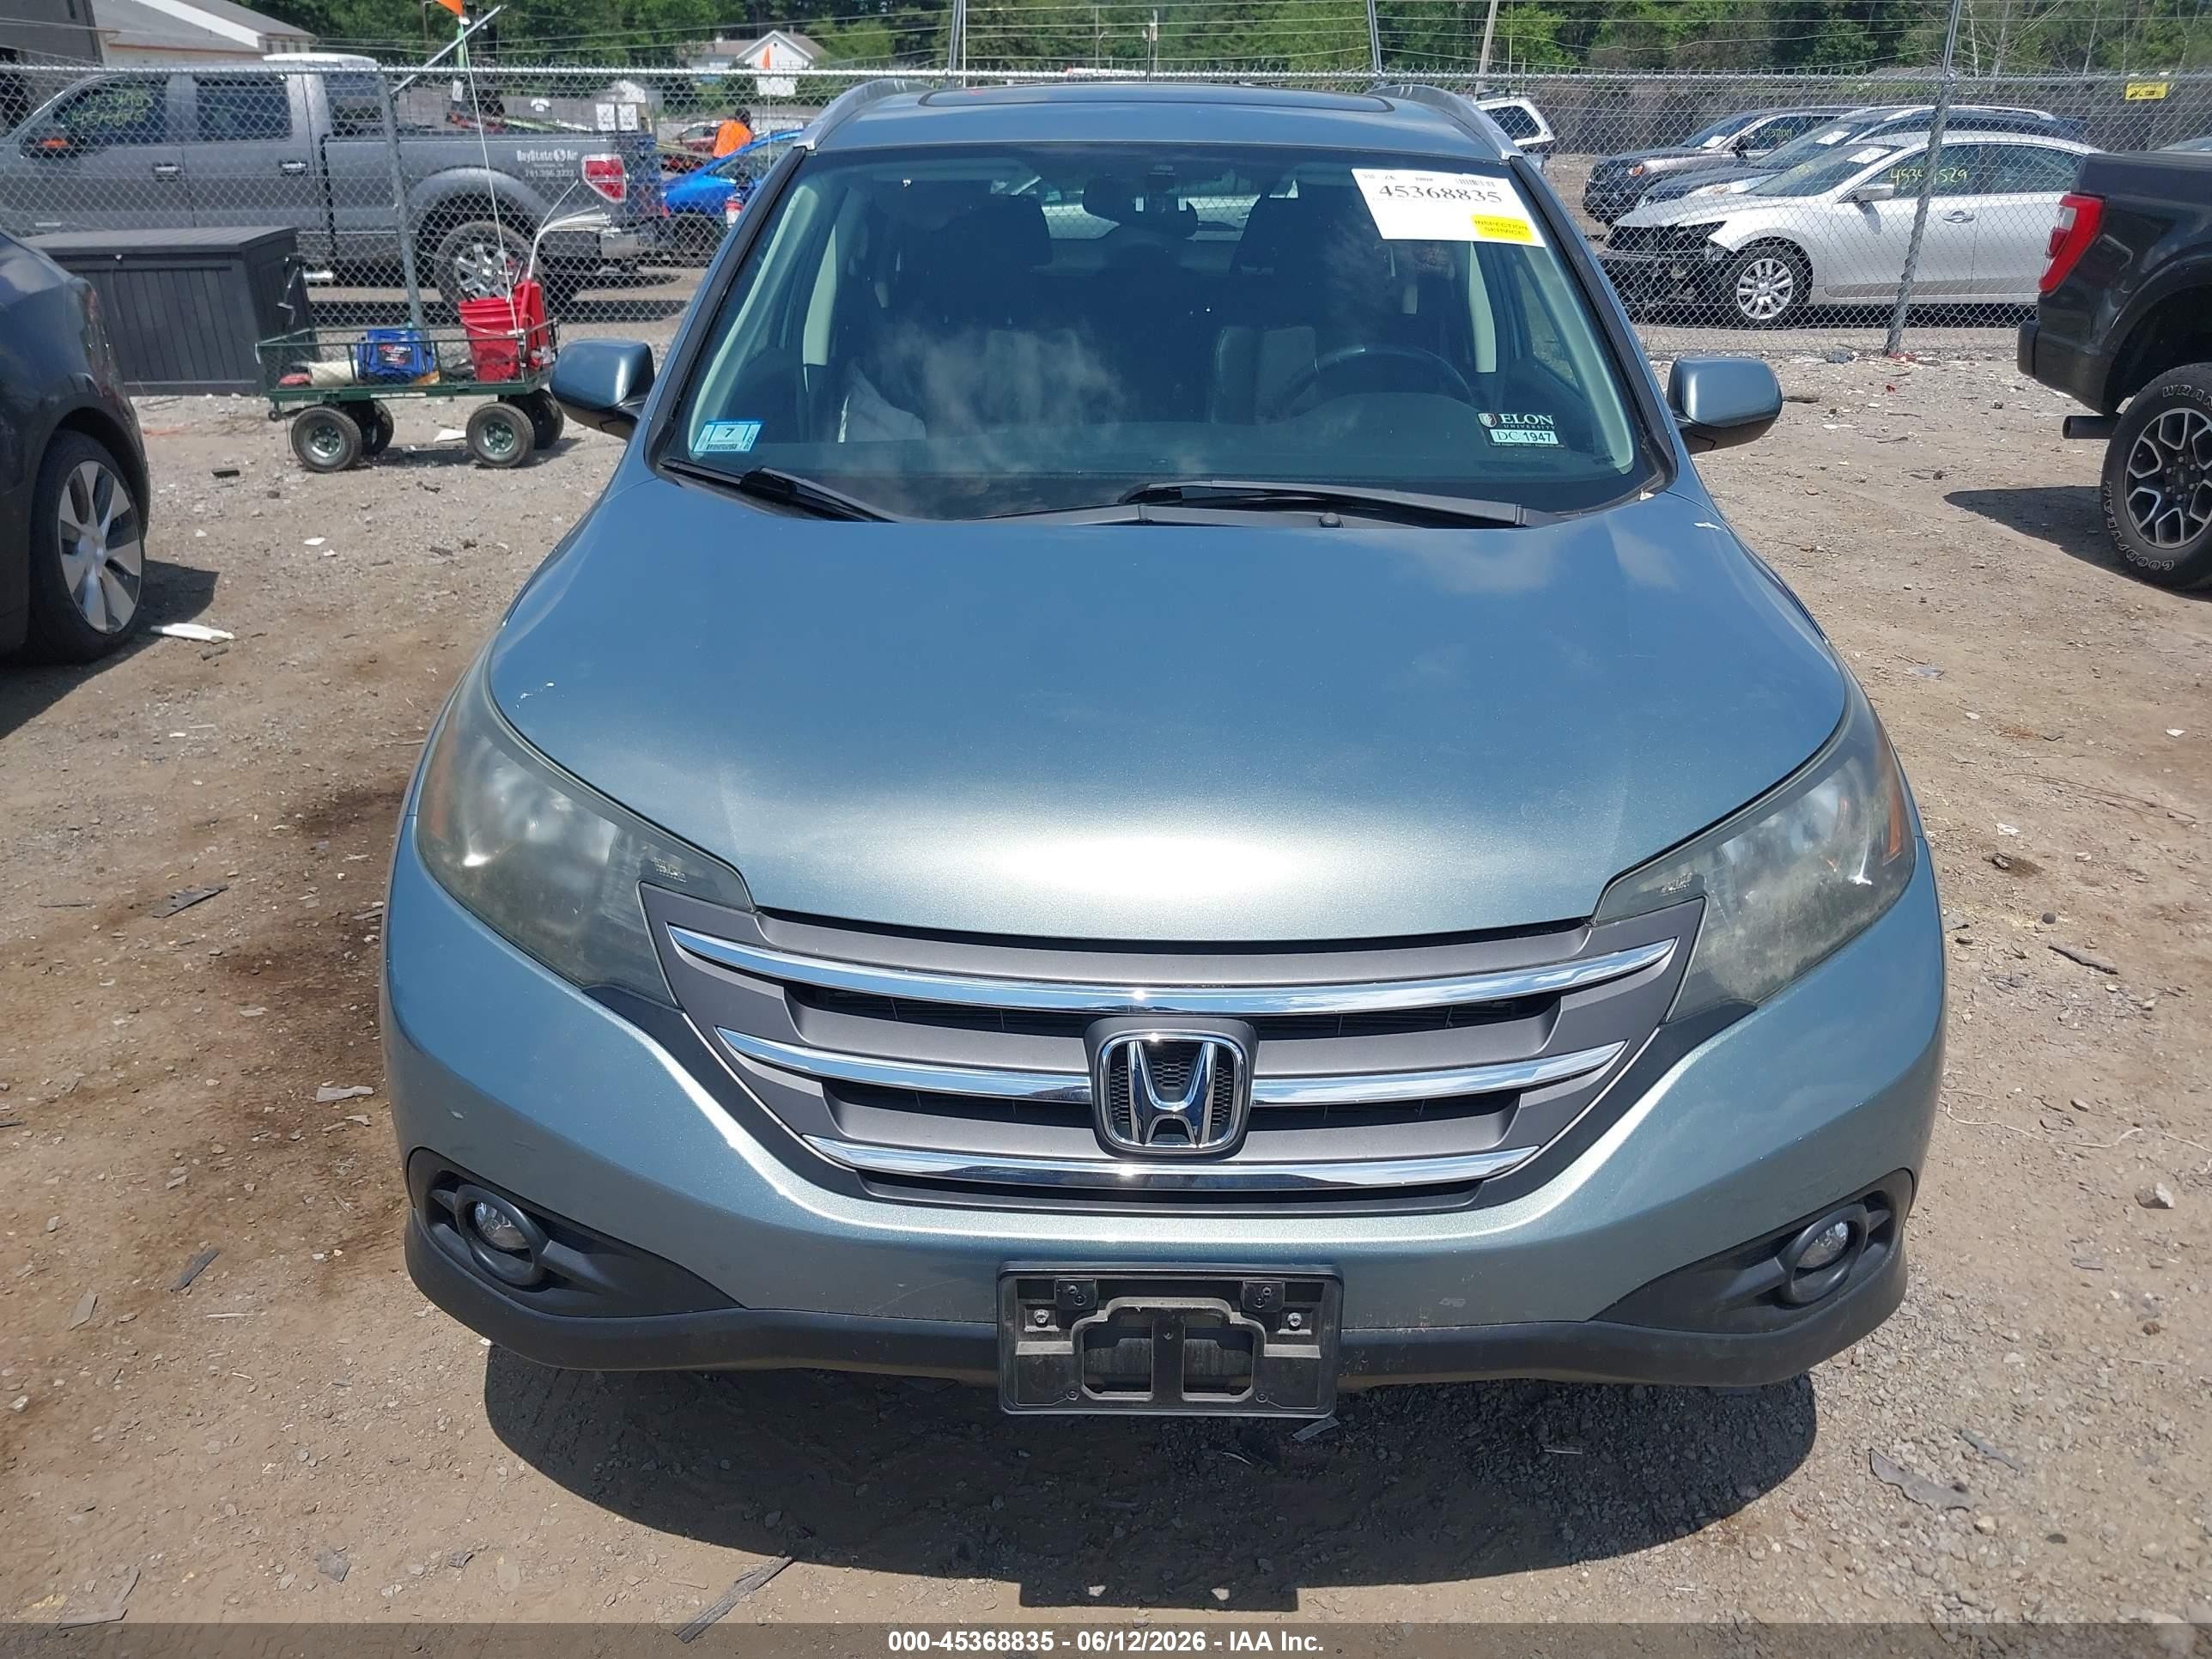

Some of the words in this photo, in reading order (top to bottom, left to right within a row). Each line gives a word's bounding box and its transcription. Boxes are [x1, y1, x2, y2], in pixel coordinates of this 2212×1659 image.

[1379, 185, 1502, 204] 45368835
[1498, 413, 1554, 426] ELON
[725, 428, 736, 438] 7
[1496, 431, 1520, 441] DC
[1523, 431, 1551, 442] 1947
[2103, 480, 2174, 571] GOODYEAR
